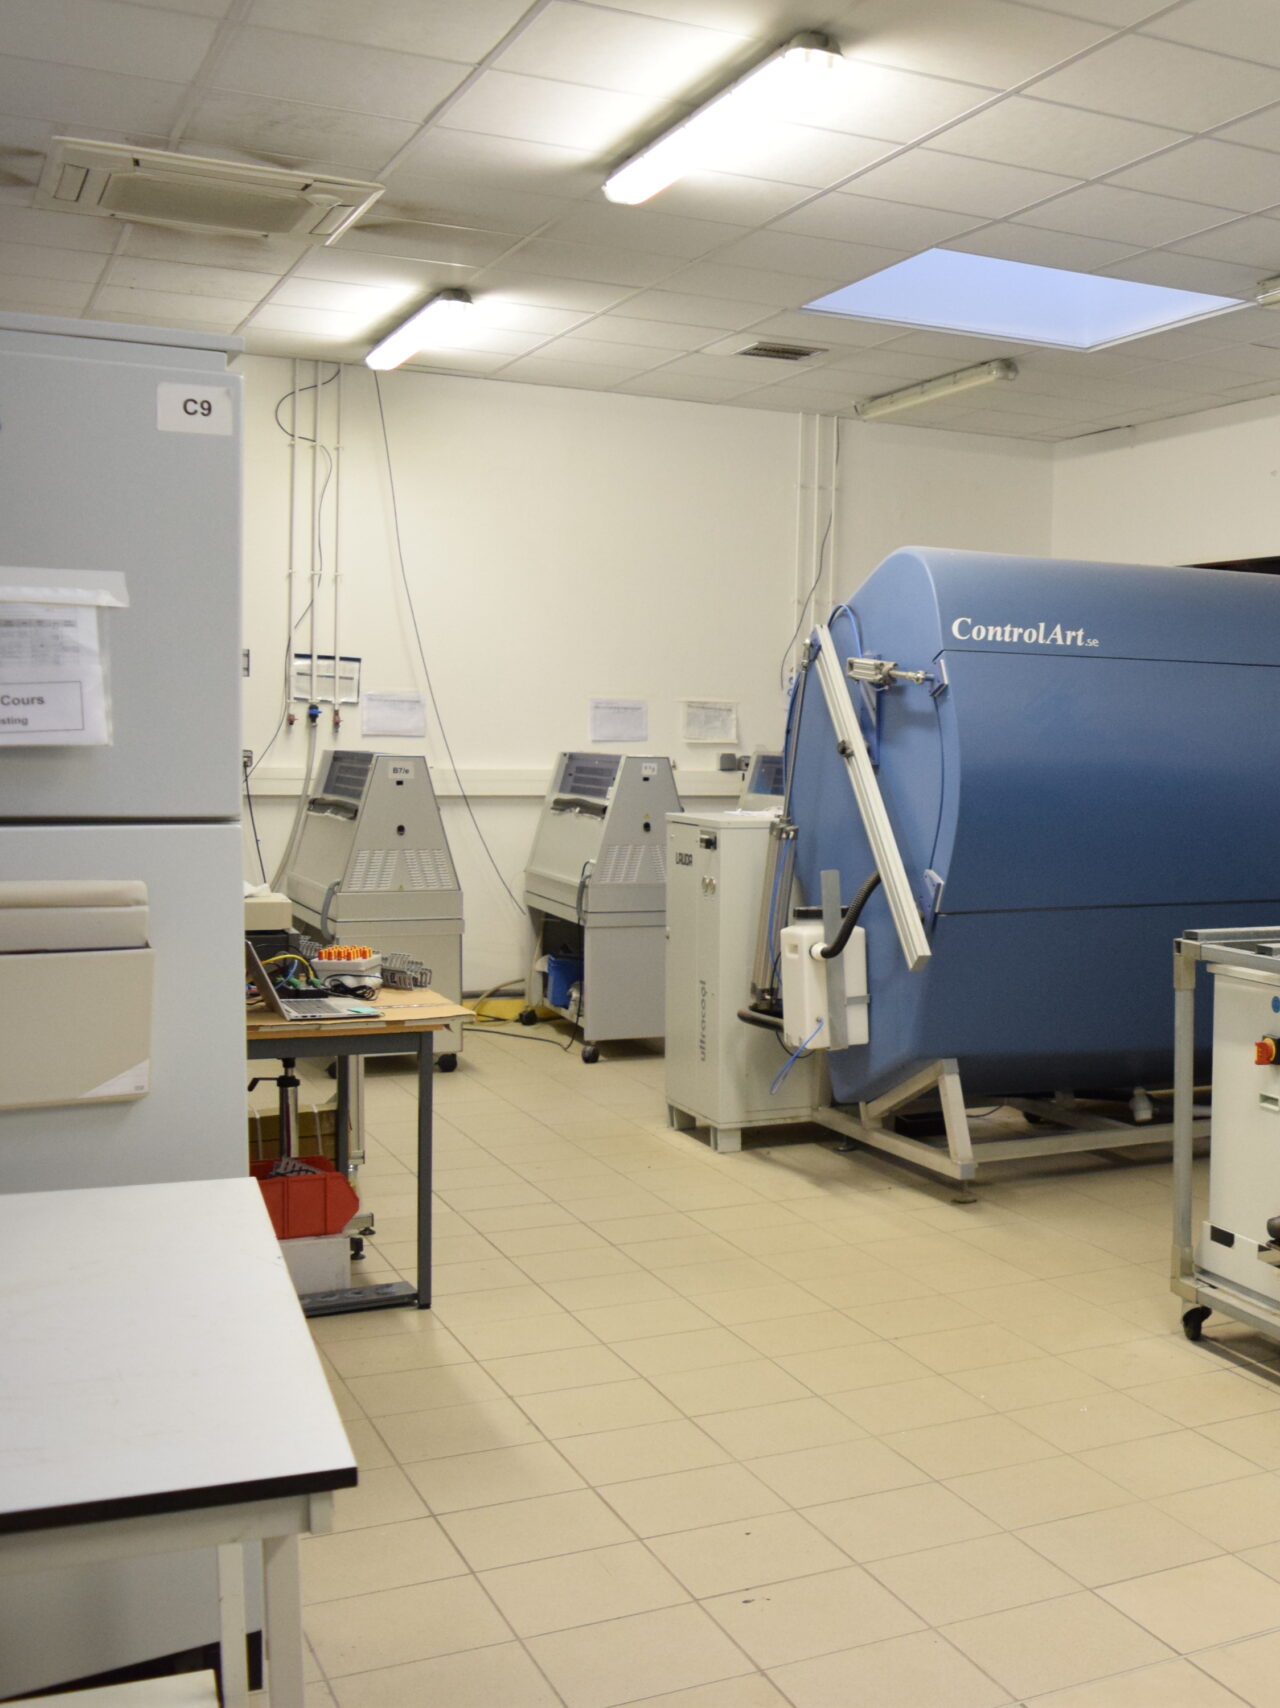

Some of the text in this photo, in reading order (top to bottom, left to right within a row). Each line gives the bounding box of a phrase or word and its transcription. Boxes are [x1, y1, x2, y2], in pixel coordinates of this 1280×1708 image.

[183, 398, 213, 417] C9
[0, 695, 45, 706] Cours
[0, 716, 29, 726] sting
